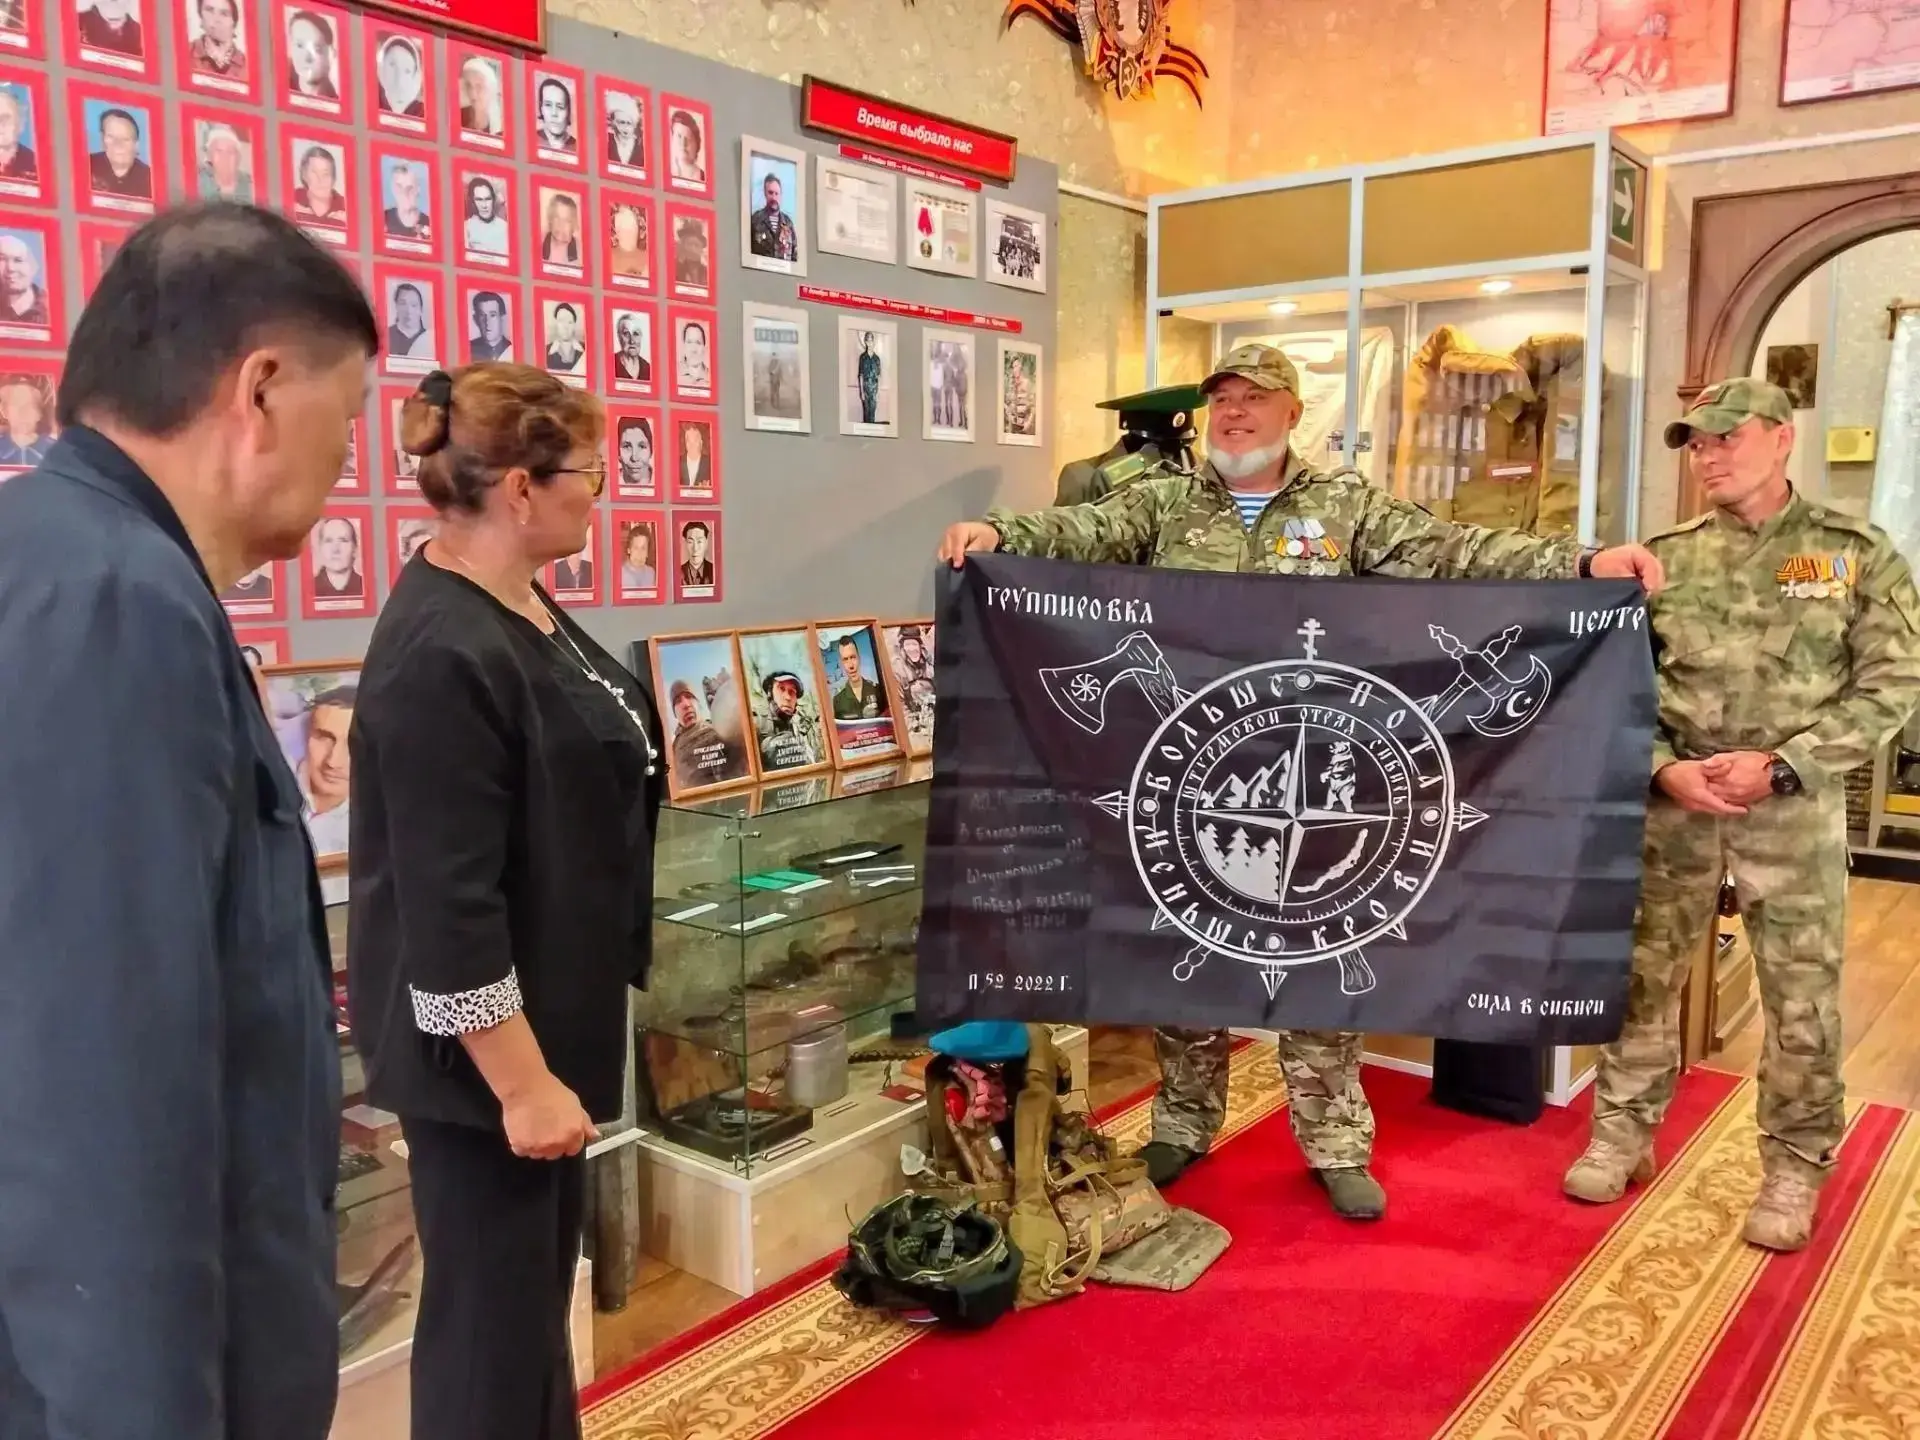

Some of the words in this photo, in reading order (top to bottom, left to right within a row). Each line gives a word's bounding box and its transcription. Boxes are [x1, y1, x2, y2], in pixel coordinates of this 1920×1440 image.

[857, 107, 897, 132] Время
[900, 122, 950, 148] выбрало
[953, 139, 973, 155] нас
[987, 586, 1153, 624] ГРУППИРОВКА
[1569, 606, 1646, 639] ЦЕНТР
[1146, 673, 1284, 791] БОЛЬШЕ
[1300, 707, 1356, 735] ОТРЯД
[1369, 739, 1408, 805] СИБИРЬ
[1135, 825, 1256, 952] МЕНЬШЕ
[1312, 839, 1436, 949] КРОВИ
[1014, 974, 1054, 991] 2022
[1467, 993, 1511, 1016] СИЛА
[1520, 997, 1533, 1015] В
[1539, 998, 1604, 1017] СИБИРИ
